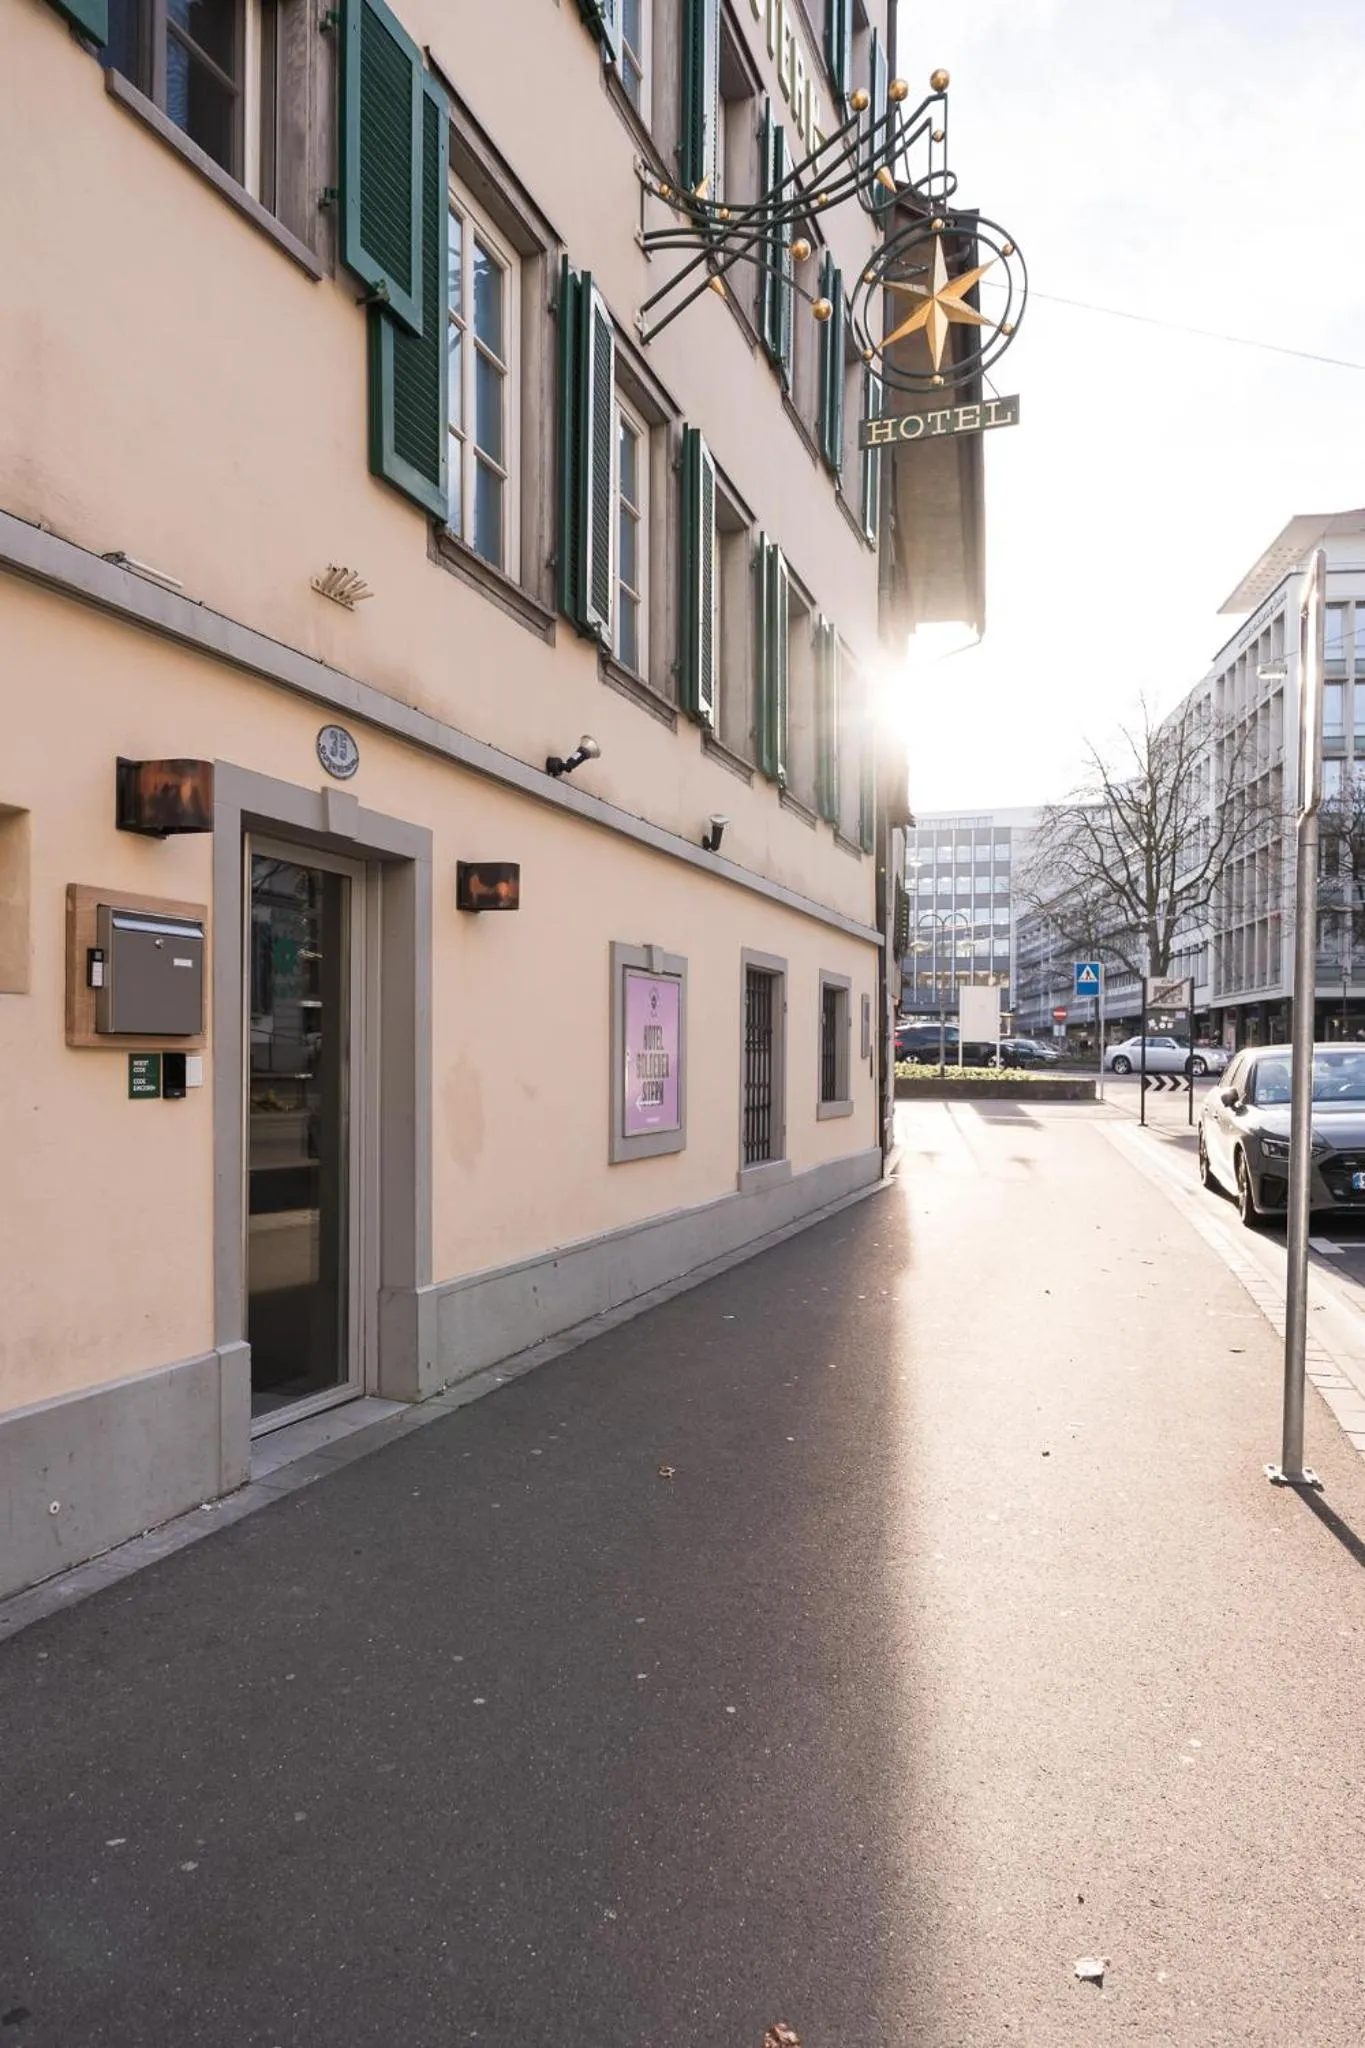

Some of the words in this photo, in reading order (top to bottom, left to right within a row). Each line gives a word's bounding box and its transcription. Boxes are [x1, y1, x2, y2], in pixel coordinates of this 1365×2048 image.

[866, 402, 1012, 445] HOTEL
[643, 1024, 664, 1050] HOTEL
[636, 1053, 669, 1079] GOLDENER
[642, 1081, 664, 1105] STERN
